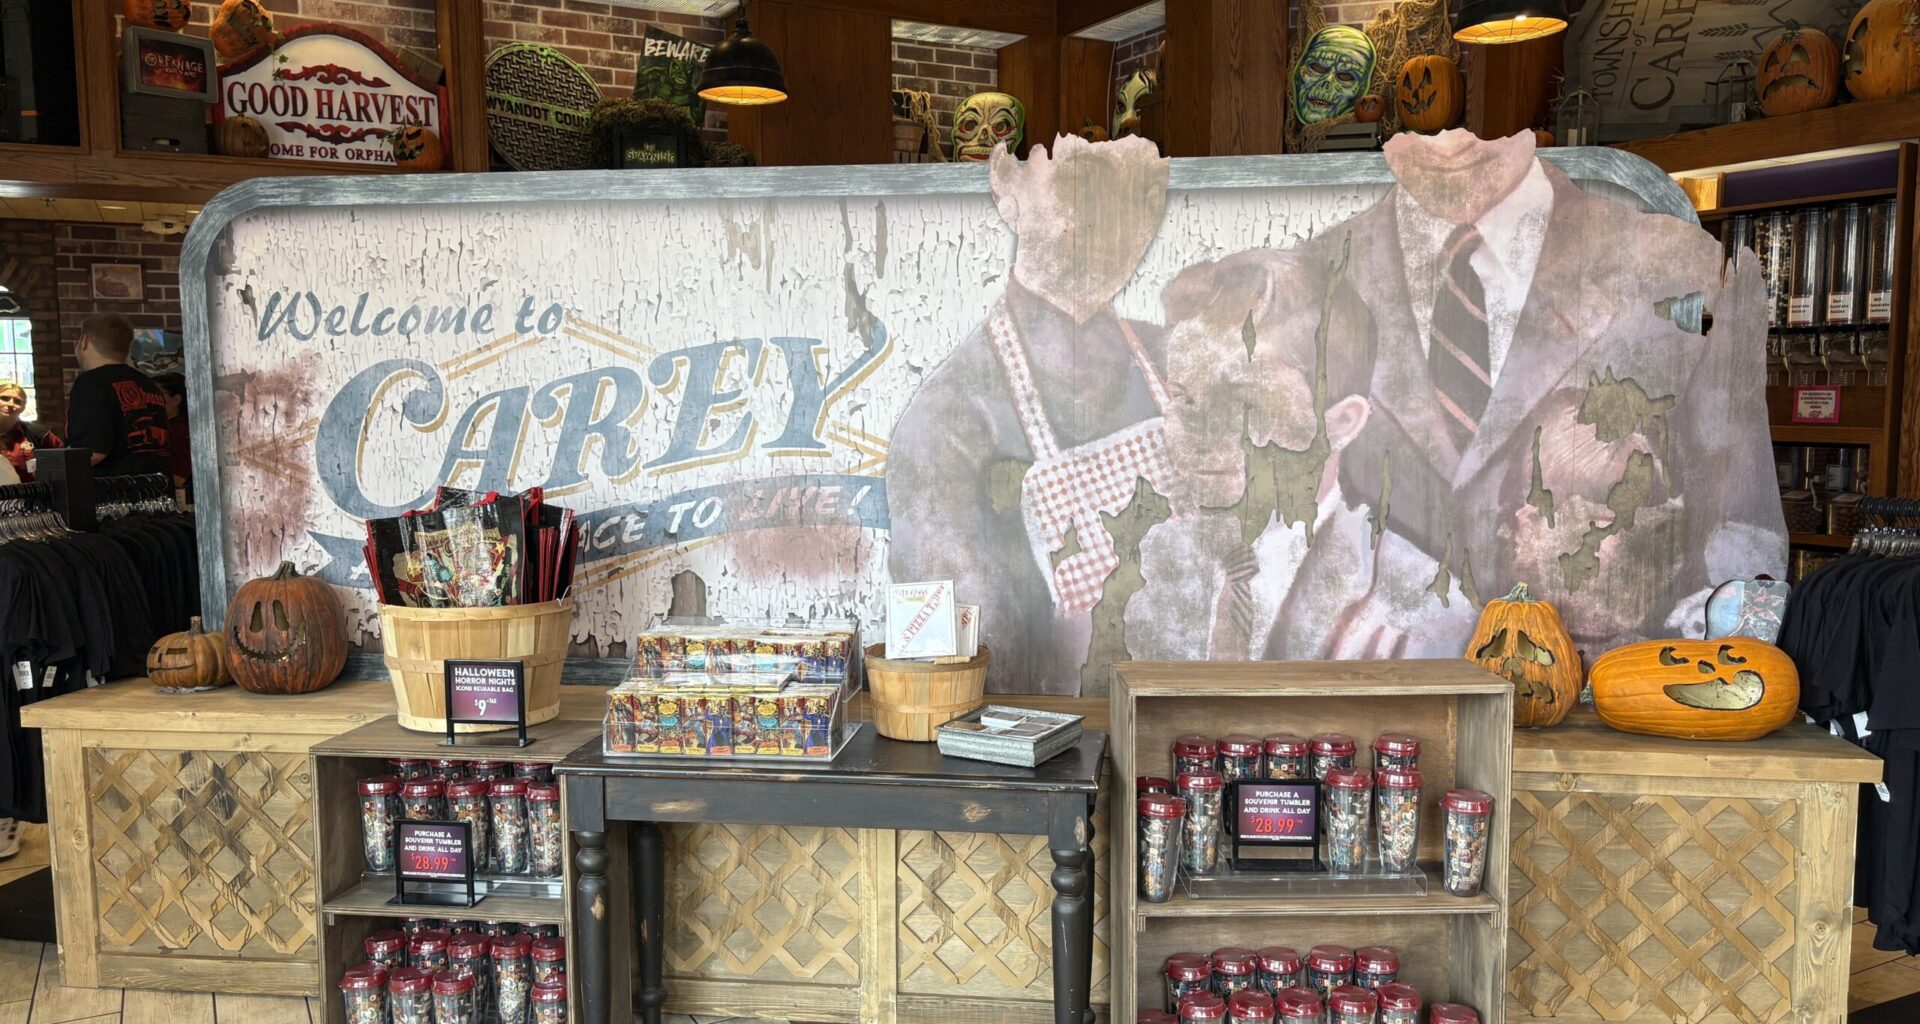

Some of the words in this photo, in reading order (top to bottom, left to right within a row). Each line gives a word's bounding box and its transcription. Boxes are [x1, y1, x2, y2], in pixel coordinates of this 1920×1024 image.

[1633, 30, 1647, 46] of
[644, 37, 712, 62] BEWARE
[1592, 0, 1639, 101] TOWNSH
[1630, 0, 1697, 110] CARE
[227, 81, 308, 117] GOOD
[314, 88, 435, 126] HARVEST
[487, 96, 549, 120] WYANDOT
[554, 110, 590, 130] COUN
[270, 142, 305, 157] OME
[310, 146, 340, 160] FOR
[345, 149, 395, 163] ORPHA
[257, 291, 494, 342] Welcome
[515, 295, 564, 335] to
[315, 319, 893, 518] CAREY
[578, 511, 649, 553] ACE
[667, 497, 723, 534] TO
[454, 667, 515, 677] HALLOWEEN
[455, 677, 486, 685] HORROR
[488, 678, 516, 686] NIGHTS
[474, 699, 487, 717] $9
[1255, 790, 1291, 798] PURCHASE
[1243, 806, 1259, 814] AND
[414, 830, 445, 838] PURCHASE
[1251, 815, 1295, 834] $28.99
[404, 836, 434, 844] SOUVENIR
[435, 838, 462, 846] TUMBLER
[410, 852, 449, 871] $28.99
